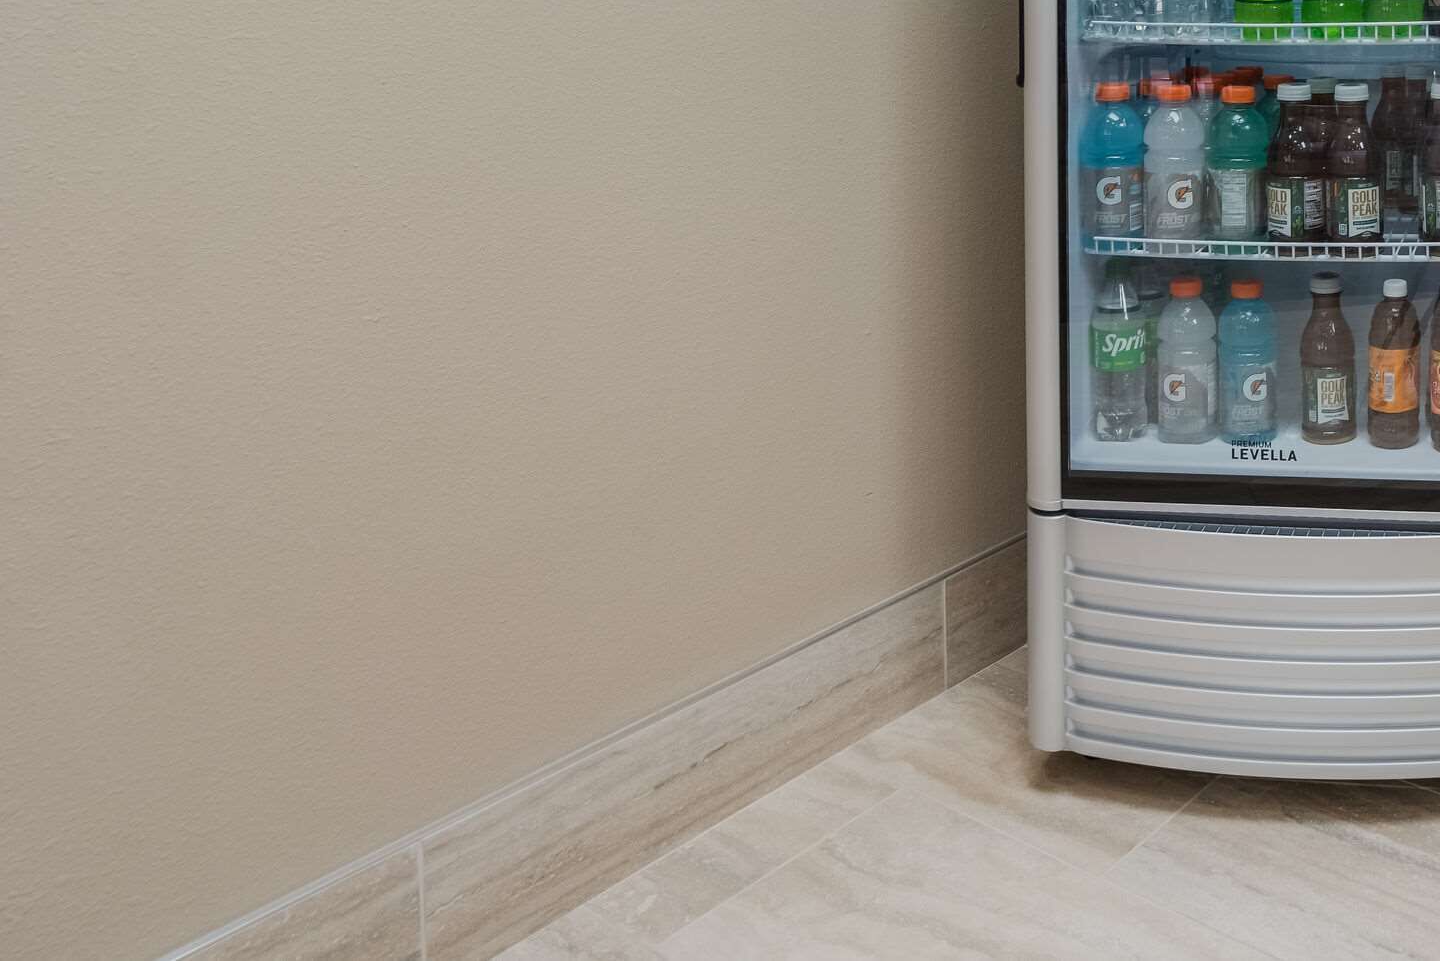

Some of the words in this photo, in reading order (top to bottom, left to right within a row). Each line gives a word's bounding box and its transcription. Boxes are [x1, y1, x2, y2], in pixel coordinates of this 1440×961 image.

[1269, 188, 1287, 203] OLD
[1351, 188, 1377, 204] GOLD
[1270, 202, 1288, 216] EAK
[1351, 202, 1378, 217] PEAK
[1102, 329, 1146, 357] Sprit
[1231, 439, 1272, 449] PREMIUM
[1231, 448, 1298, 462] LEVELLA
